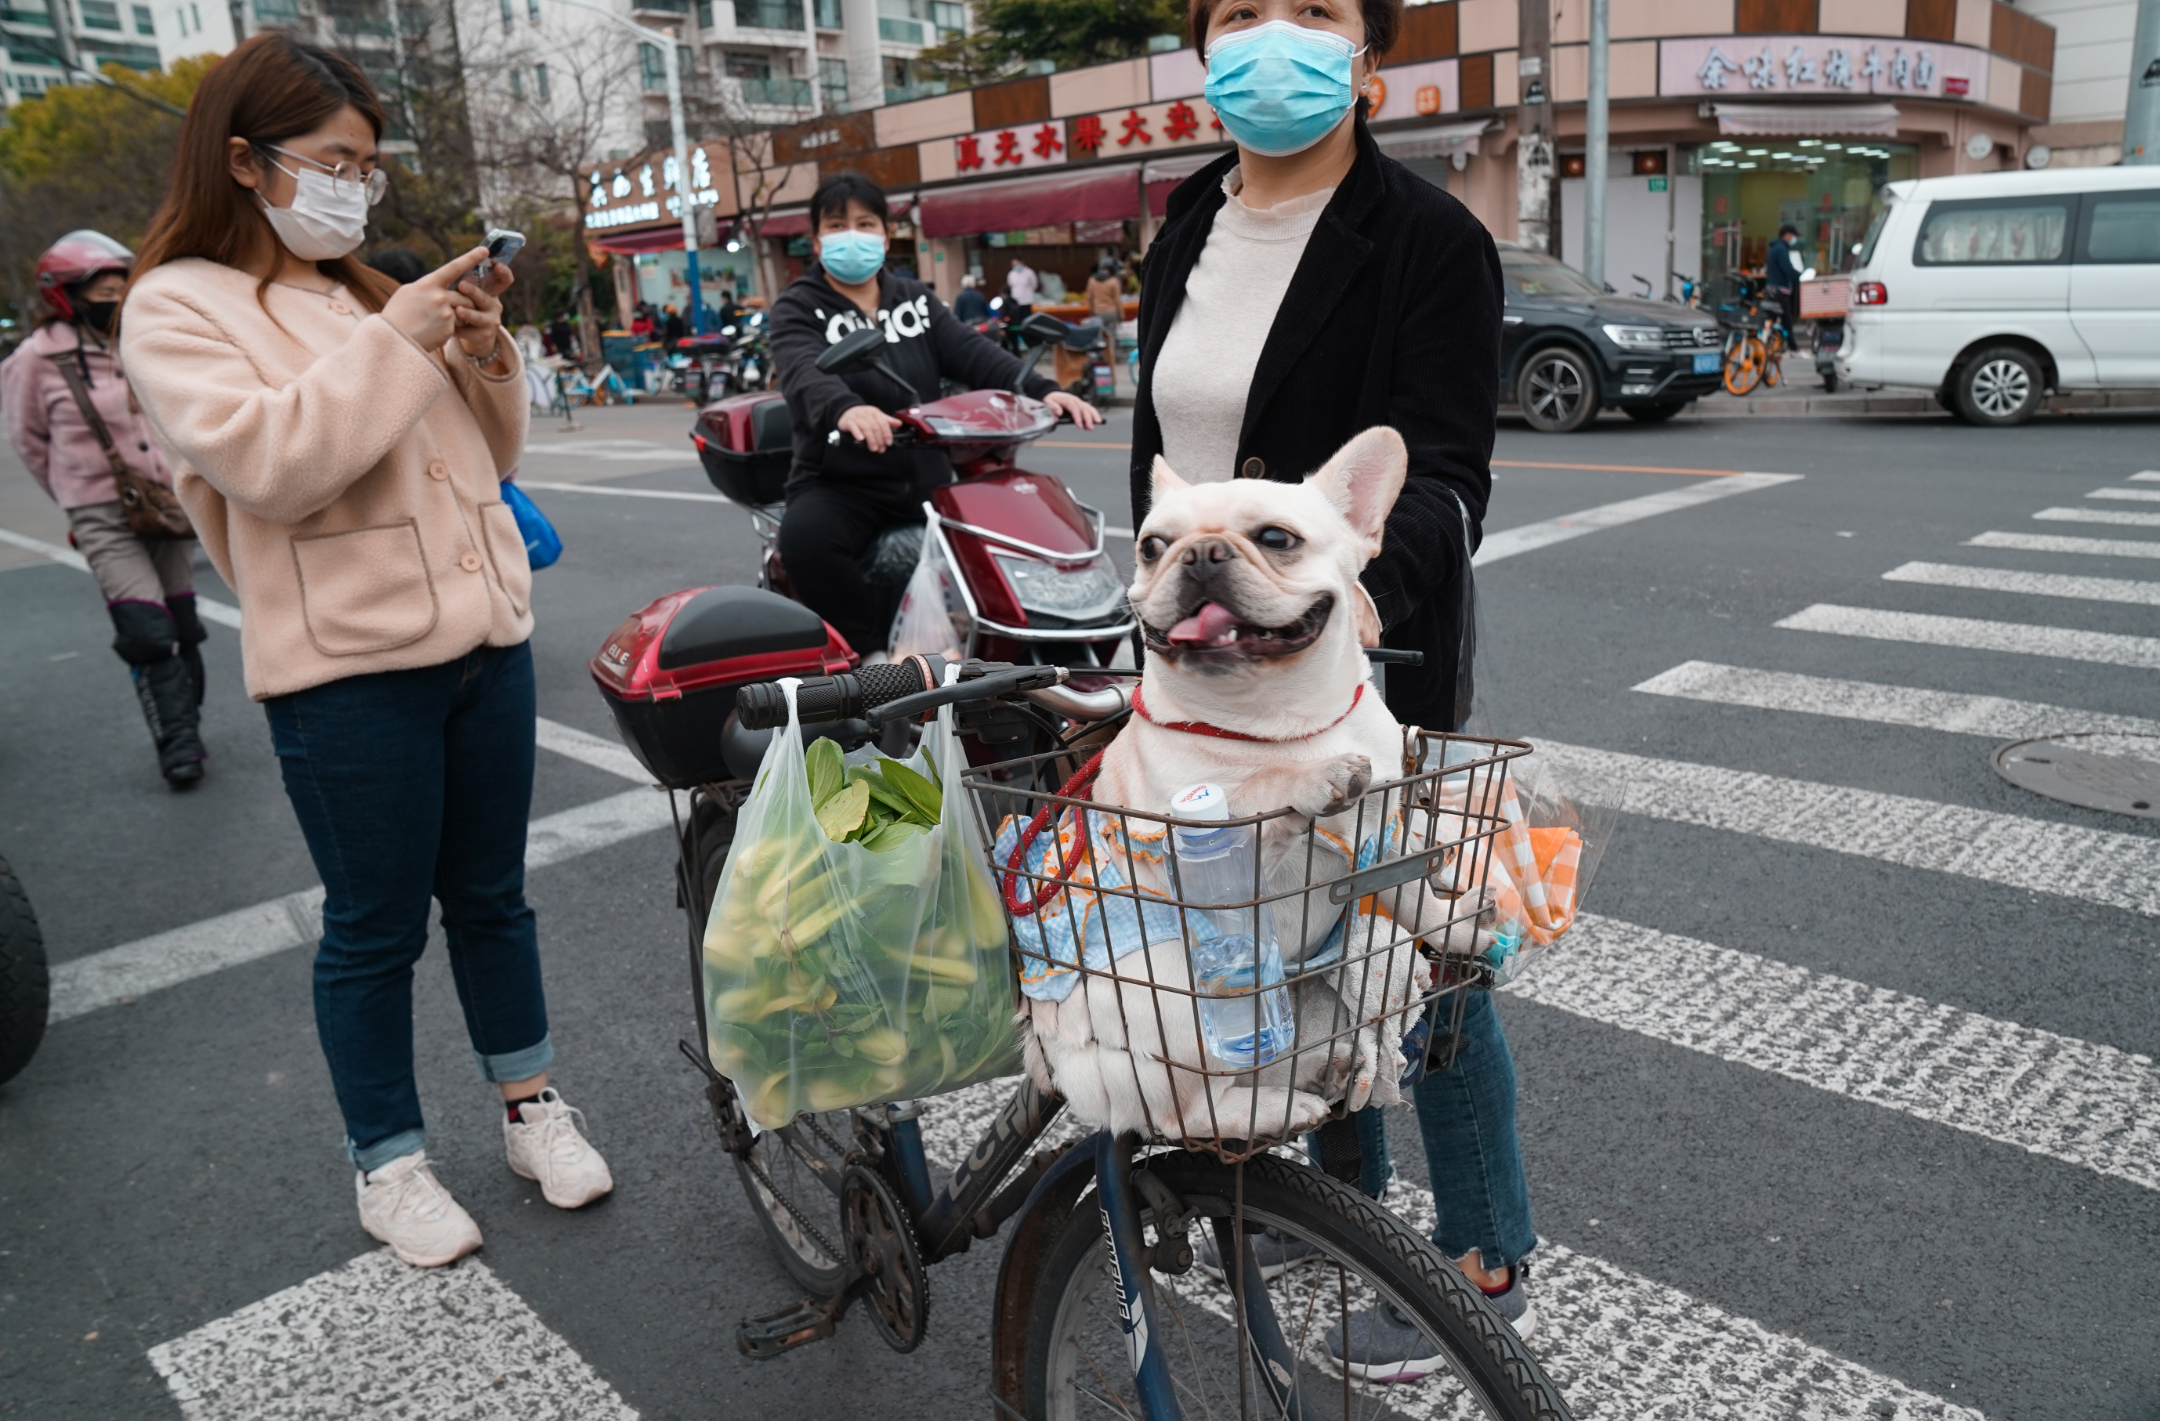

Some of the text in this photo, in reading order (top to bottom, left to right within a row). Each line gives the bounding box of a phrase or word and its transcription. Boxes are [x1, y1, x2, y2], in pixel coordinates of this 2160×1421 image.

[1697, 46, 1936, 92] 余味红烧牛肉面
